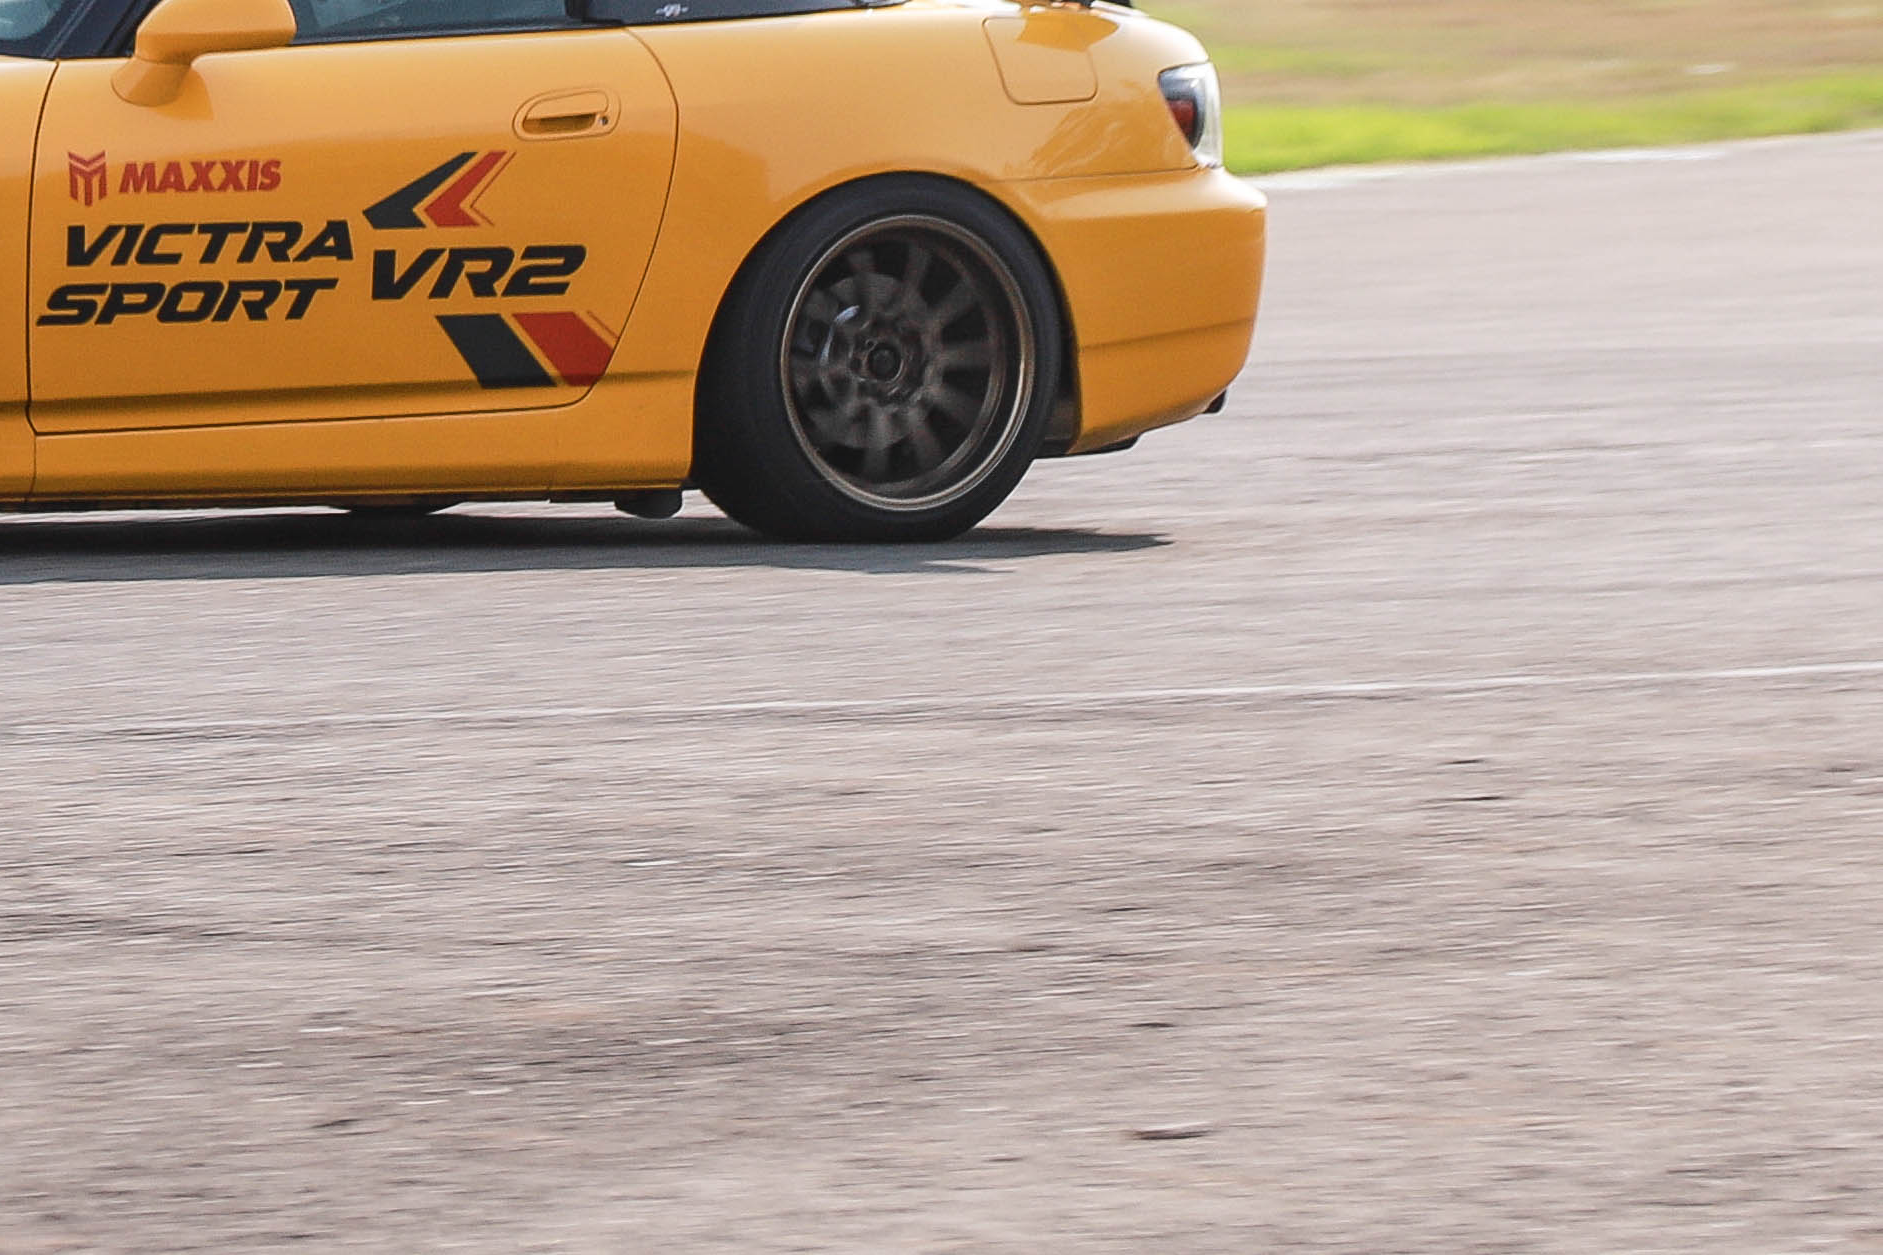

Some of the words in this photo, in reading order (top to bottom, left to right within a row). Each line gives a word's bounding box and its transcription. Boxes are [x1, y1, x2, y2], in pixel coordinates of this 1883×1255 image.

[119, 159, 282, 194] MAXXIS
[66, 220, 354, 267] VICTRA
[371, 244, 587, 301] VR2
[36, 278, 339, 327] SPORT
